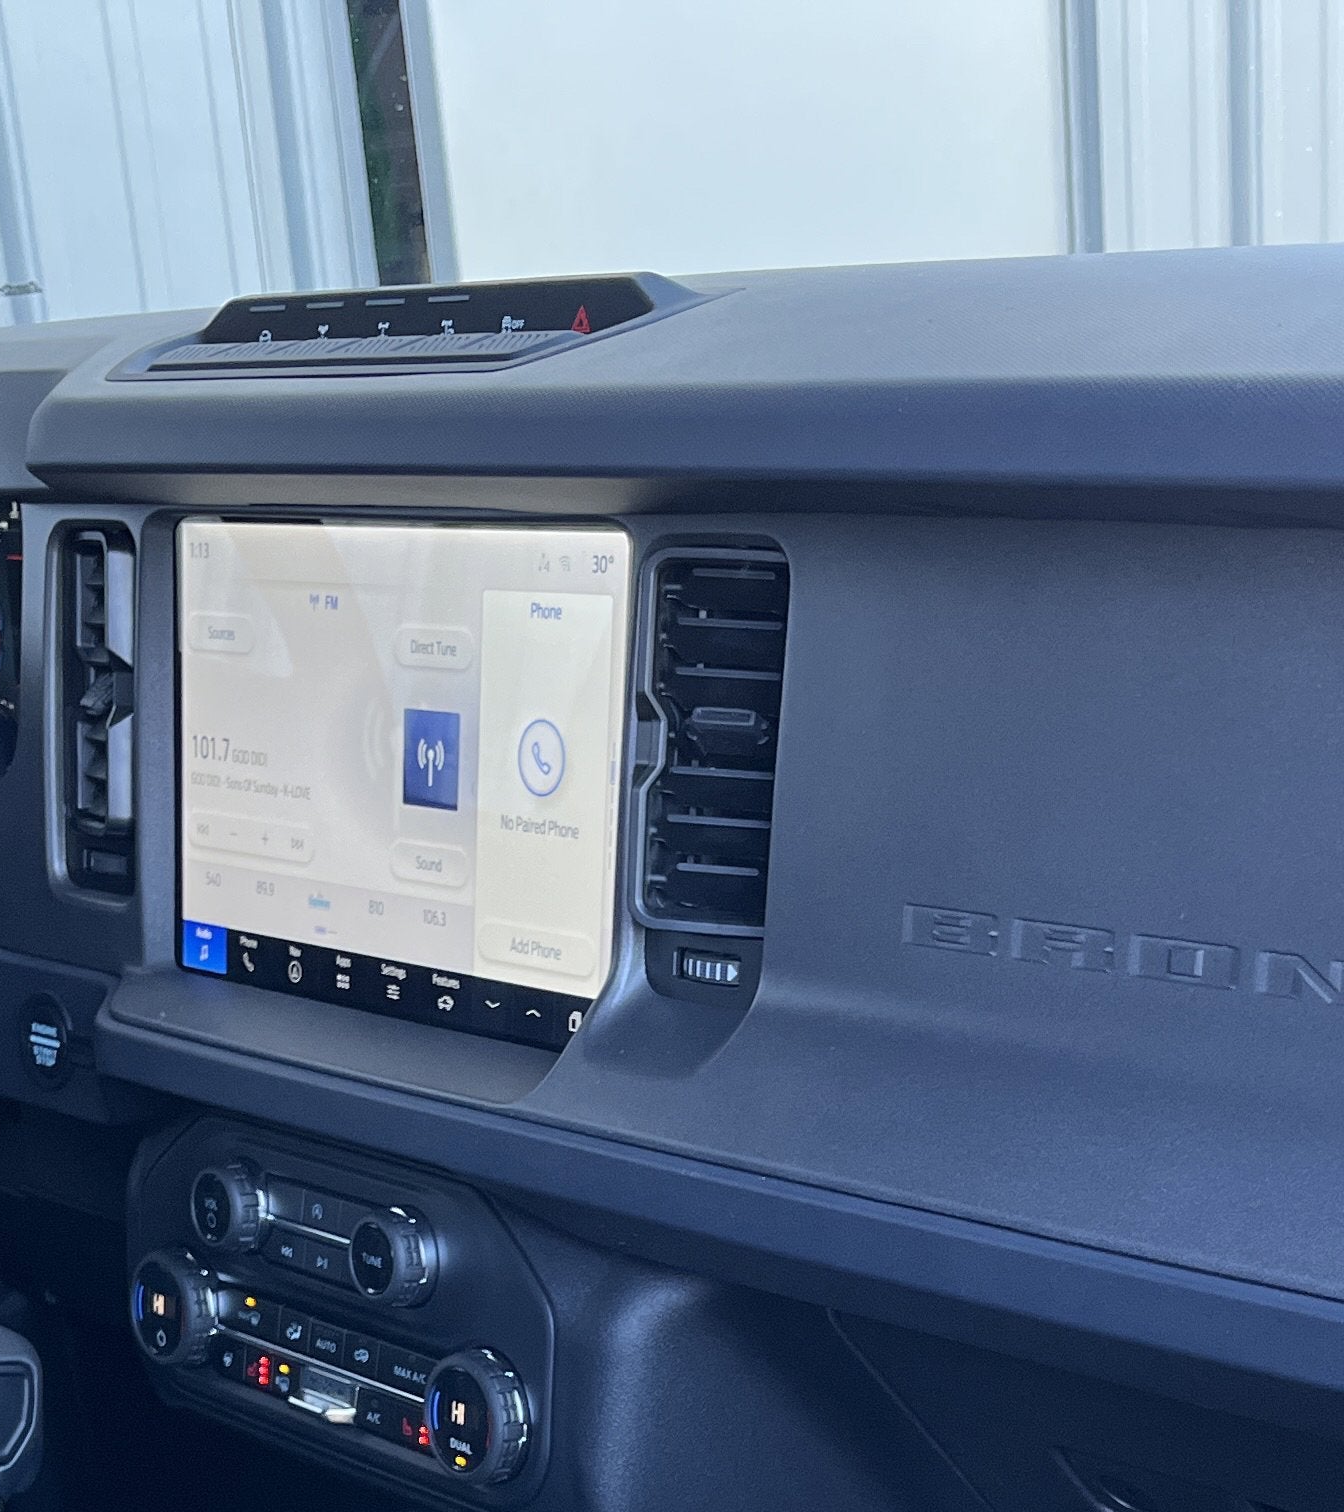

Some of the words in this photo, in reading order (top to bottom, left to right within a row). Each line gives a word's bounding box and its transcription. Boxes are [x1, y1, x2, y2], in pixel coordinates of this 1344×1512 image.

[325, 595, 338, 610] FM
[530, 602, 563, 620] Phone
[410, 640, 434, 655] Direct
[436, 641, 457, 657] Tune
[192, 735, 230, 761] 101.7
[500, 814, 514, 831] No
[516, 816, 546, 836] Paired
[548, 820, 580, 840] Phone
[415, 855, 442, 873] Sound
[422, 909, 446, 927] 106.3
[510, 937, 529, 955] Add
[530, 941, 562, 961] Phone
[380, 963, 407, 980] Settings
[361, 1252, 382, 1268] TUNE
[316, 1338, 337, 1353] AUTO
[393, 1365, 412, 1379] MAX
[366, 1411, 381, 1425] A/C
[449, 1437, 473, 1455] DUAL
